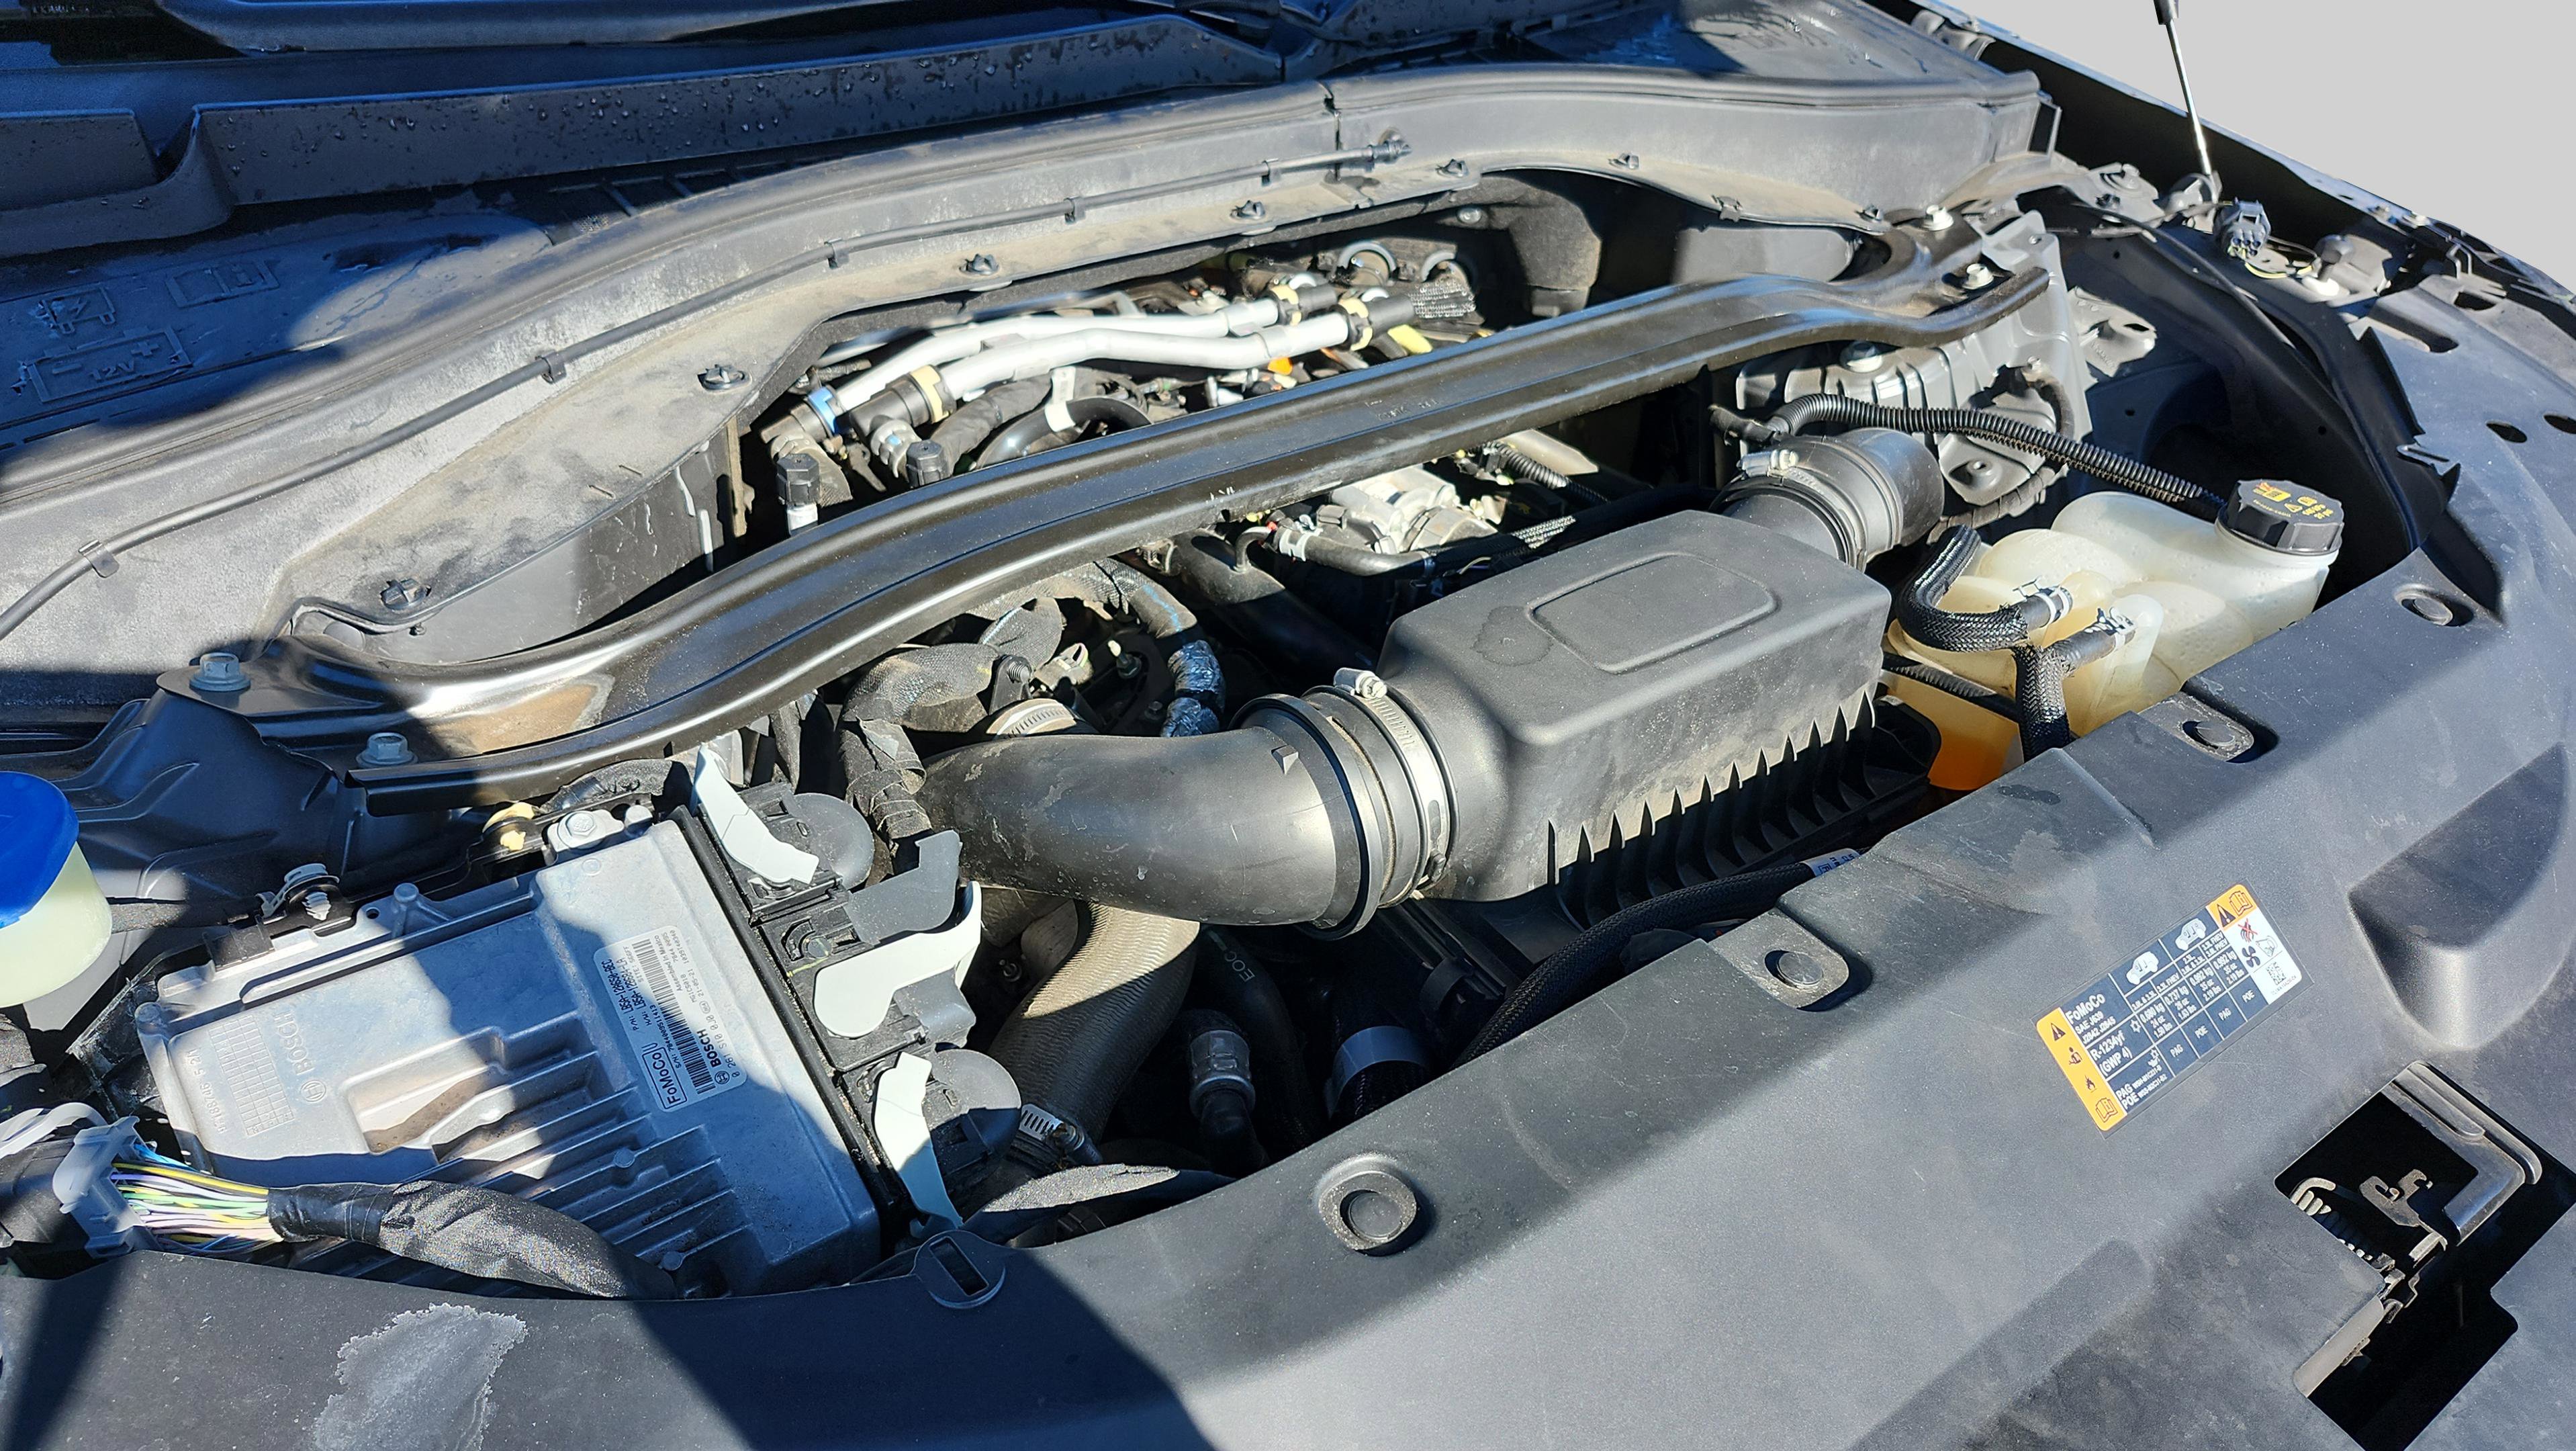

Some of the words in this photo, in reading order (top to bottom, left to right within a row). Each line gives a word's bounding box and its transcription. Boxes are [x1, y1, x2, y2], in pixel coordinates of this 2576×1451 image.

[89, 361, 134, 383] 12V
[652, 934, 665, 955] Mexico
[668, 947, 679, 962] 7844
[2211, 953, 2230, 970] 0.992
[2225, 948, 2238, 963] kg
[631, 963, 644, 982] SITE:
[664, 961, 682, 992] Assembled
[2188, 969, 2207, 987] 0.992
[2201, 964, 2215, 979] kg
[2222, 964, 2232, 975] 35
[2229, 961, 2238, 971] oz
[2225, 971, 2238, 985] 2.19
[2234, 967, 2245, 978] lbs
[600, 958, 634, 1014] LB5A-12A650-BEC
[686, 968, 704, 997] 21-05-21
[2199, 980, 2209, 992] 35
[2205, 977, 2215, 987] oz
[2162, 988, 2182, 1006] 0.737
[2176, 983, 2191, 998] kg
[2180, 996, 2191, 1006] oz
[2201, 988, 2215, 1002] 2.19
[2211, 983, 2222, 995] lbs
[2241, 989, 2256, 1003] POE
[2064, 990, 2107, 1024] FoMoCo
[2153, 1000, 2166, 1015] kg
[2186, 1002, 2197, 1014] lbs
[2217, 1006, 2232, 1020] PAG
[627, 1014, 639, 1030] P/N:
[640, 1010, 652, 1026] H/W:
[2074, 1019, 2090, 1035] SAE
[2086, 1010, 2105, 1026] J639
[2149, 1017, 2160, 1028] 24
[2156, 1014, 2166, 1024] oz
[2162, 1020, 2173, 1032] lbs
[2080, 1026, 2101, 1045] J2842
[2194, 1024, 2209, 1039] POE
[273, 1010, 316, 1075] BOSCH
[696, 1028, 722, 1067] BOSCH
[2088, 1028, 2128, 1063] R-1234yf
[2169, 1043, 2184, 1058] PAG
[670, 1053, 682, 1069] S/N:
[723, 1052, 736, 1069] 261
[2097, 1050, 2126, 1078] (GWP
[2119, 1045, 2134, 1062] 4)
[648, 1051, 681, 1104] FoMoCo
[2115, 1082, 2133, 1100] PAG
[2120, 1090, 2140, 1110] POE
